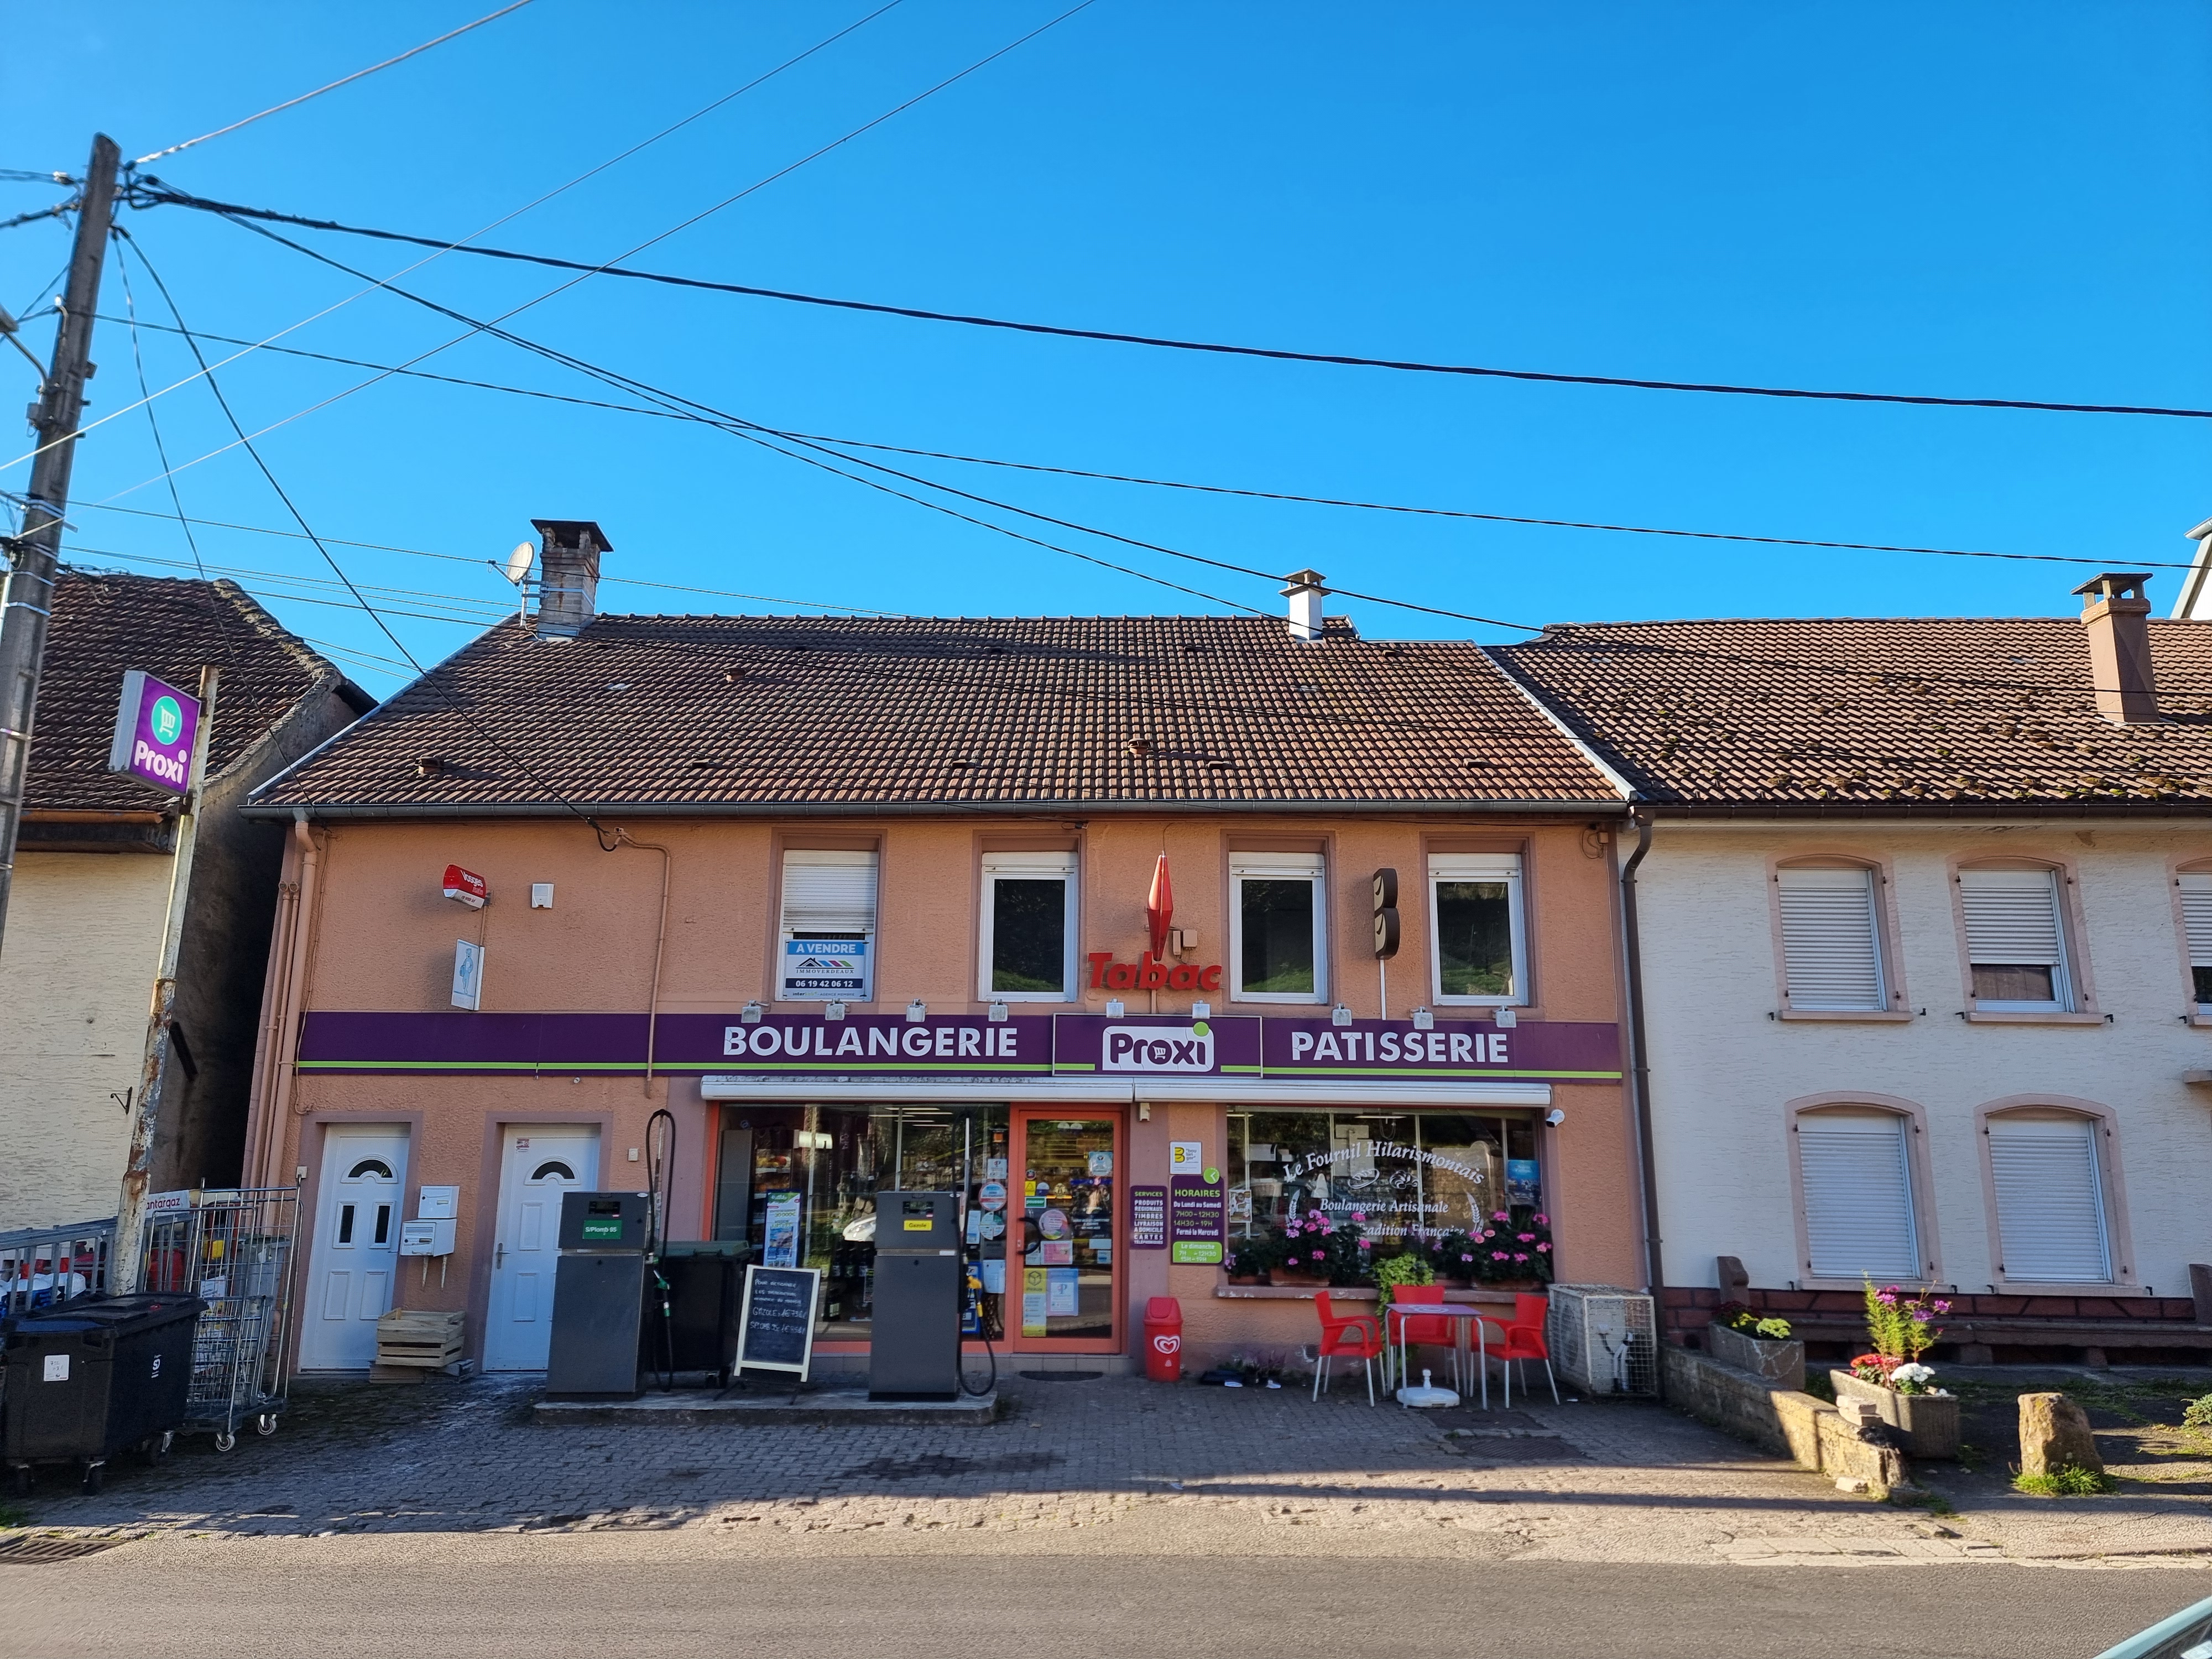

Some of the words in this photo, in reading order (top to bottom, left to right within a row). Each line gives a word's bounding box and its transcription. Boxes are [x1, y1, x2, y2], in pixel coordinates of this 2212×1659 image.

[134, 739, 189, 784] Proxi
[460, 869, 483, 888] Vosges
[796, 944, 805, 953] A
[807, 944, 855, 953] VENDRE
[1087, 951, 1222, 992] Tabac
[723, 1026, 1018, 1057] BOULANGERIE
[1110, 1021, 1210, 1066] Proxi
[1291, 1031, 1509, 1063] PATISSERIE
[1283, 1161, 1303, 1184] Le
[1305, 1143, 1361, 1171] Fournil
[1365, 1141, 1485, 1185] Hilarismontais
[1175, 1189, 1220, 1198] HORAIRES
[1320, 1198, 1386, 1214] Boulangerie
[1389, 1199, 1449, 1213] Artisanale
